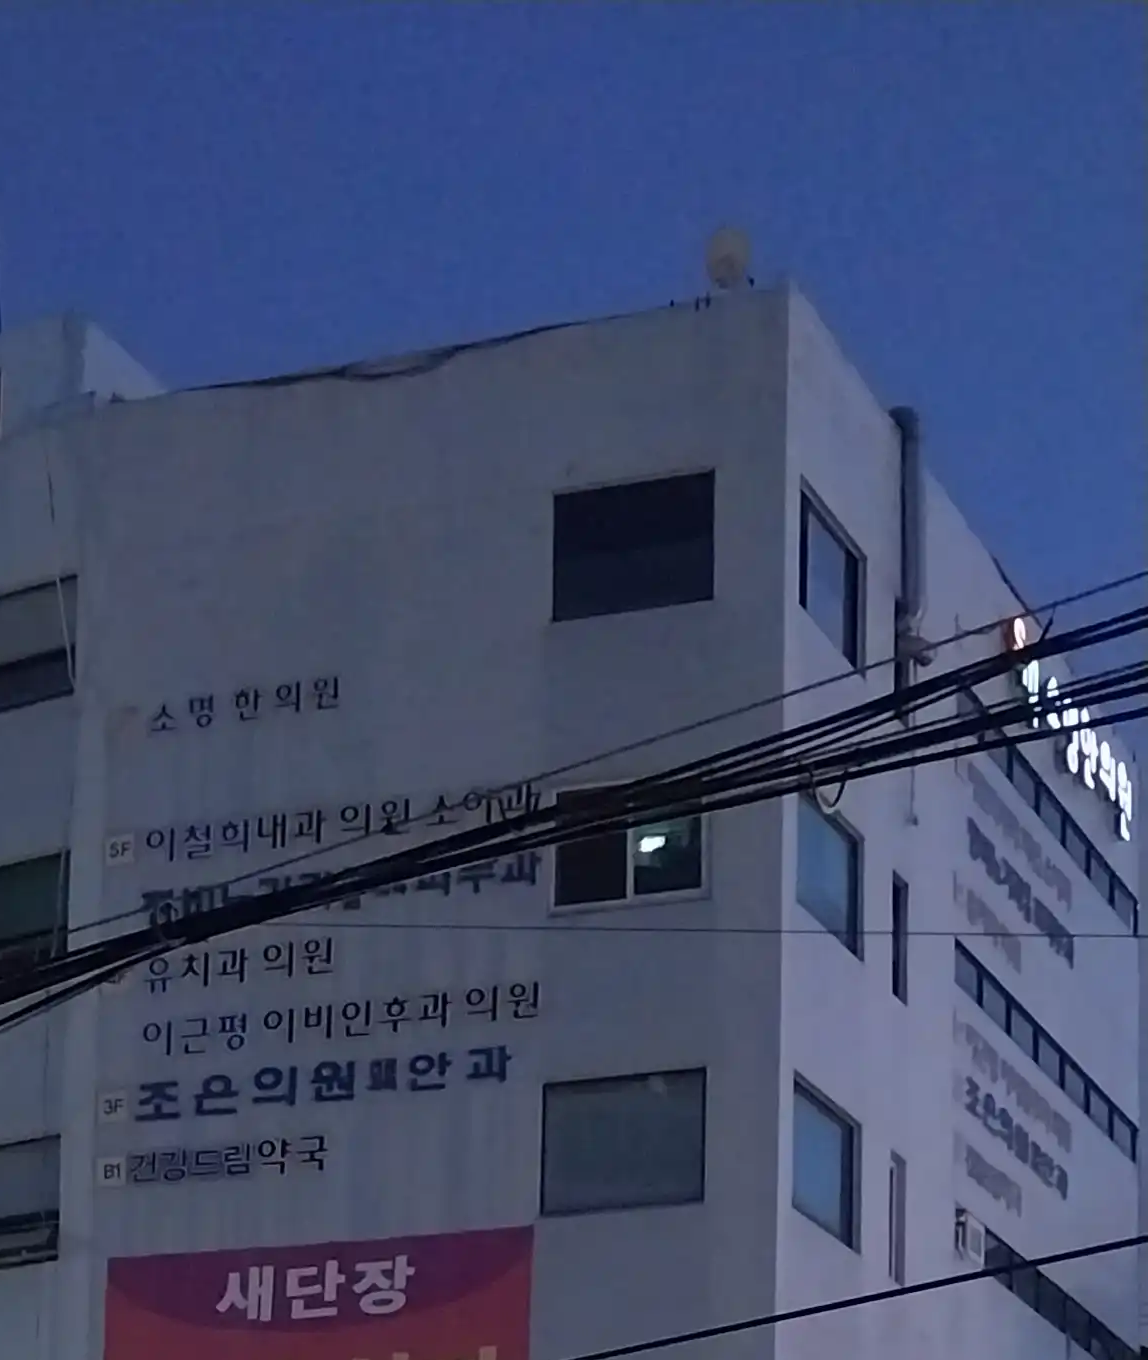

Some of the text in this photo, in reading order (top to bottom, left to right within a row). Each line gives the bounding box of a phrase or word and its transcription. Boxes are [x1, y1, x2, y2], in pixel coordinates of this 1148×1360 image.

[339, 797, 412, 838] 의원
[144, 937, 336, 993] 유치과 의원
[142, 981, 542, 1056] 이근평 이비인후과 의원
[216, 1255, 415, 1321] 새단장
